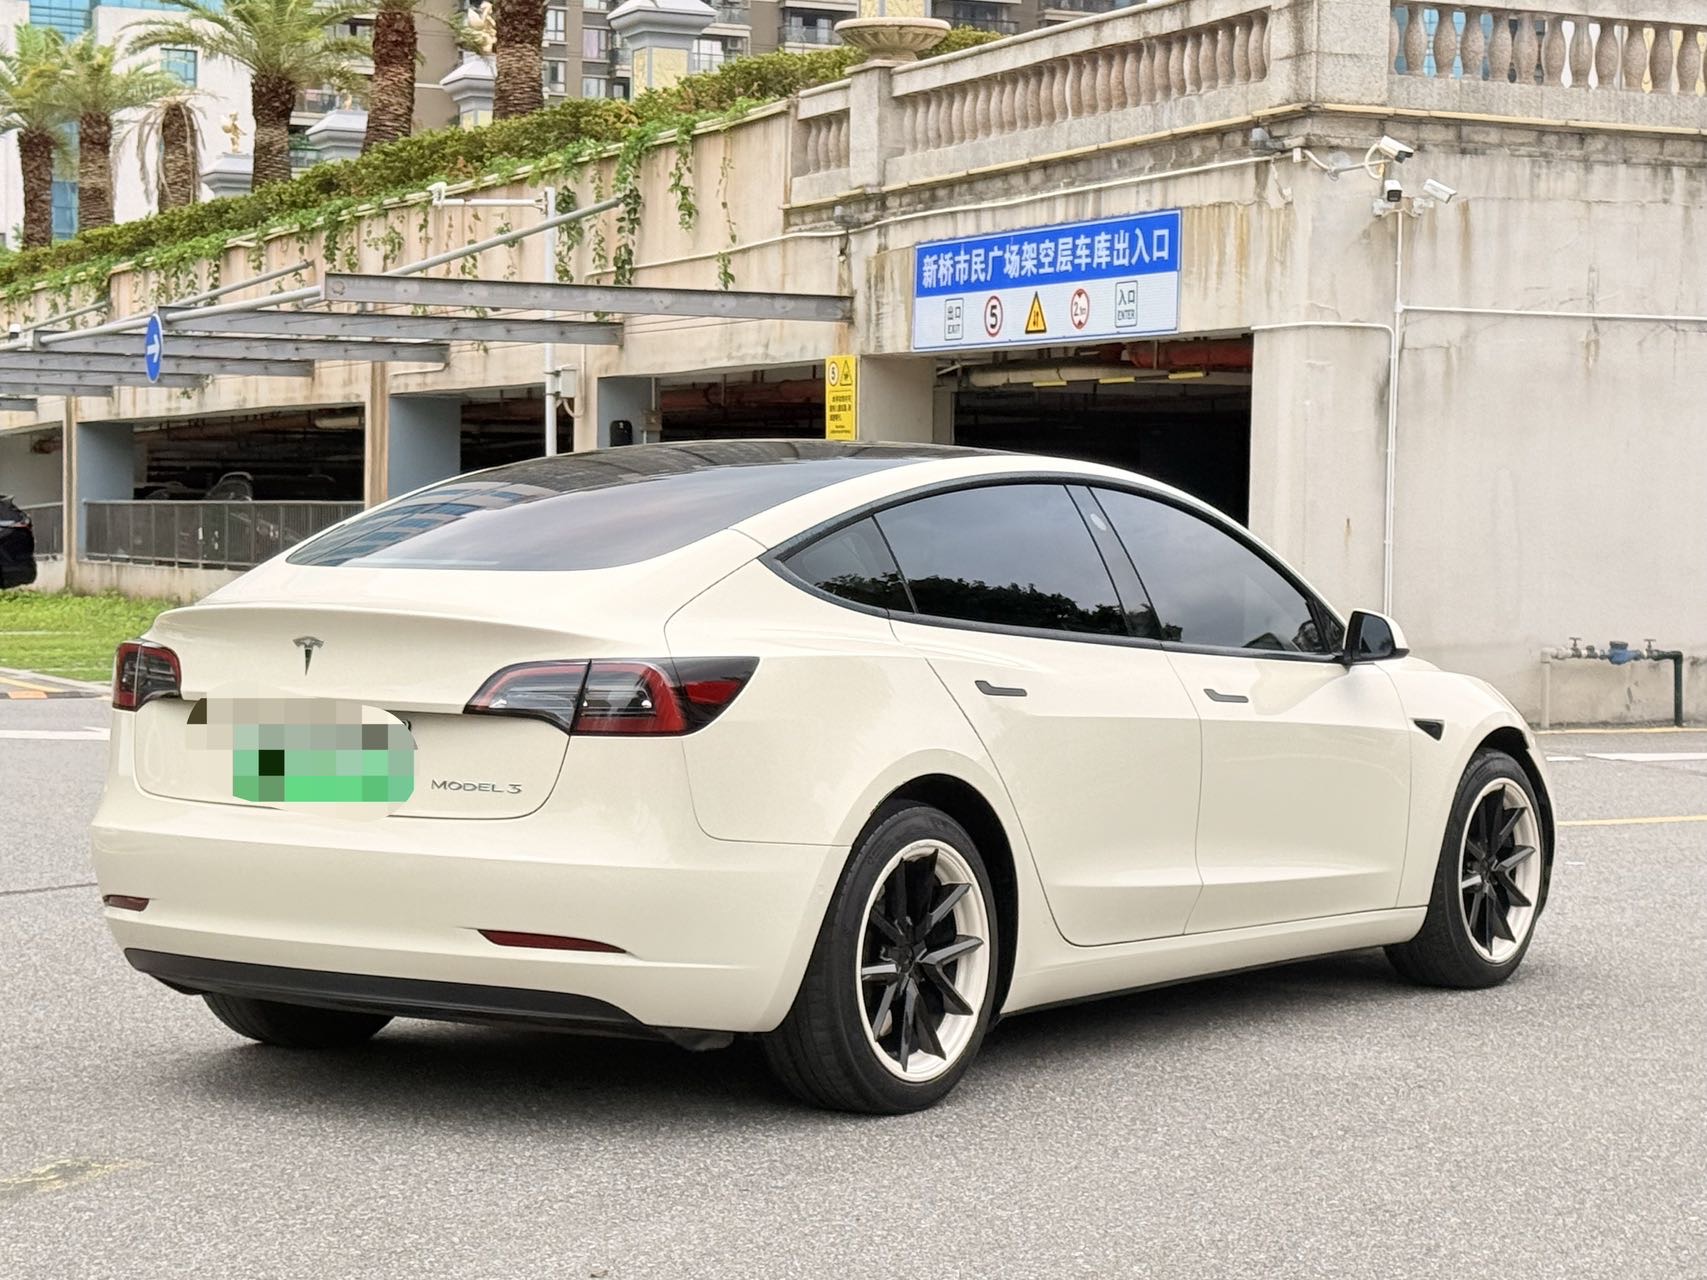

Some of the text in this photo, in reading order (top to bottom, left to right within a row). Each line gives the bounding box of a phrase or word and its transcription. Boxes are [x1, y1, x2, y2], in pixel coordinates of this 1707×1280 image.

[922, 228, 1169, 288] 新桥市民广场架空层车库出入口
[1118, 289, 1135, 305] 入口
[990, 305, 998, 329] 5
[431, 779, 522, 794] MODEL 3
